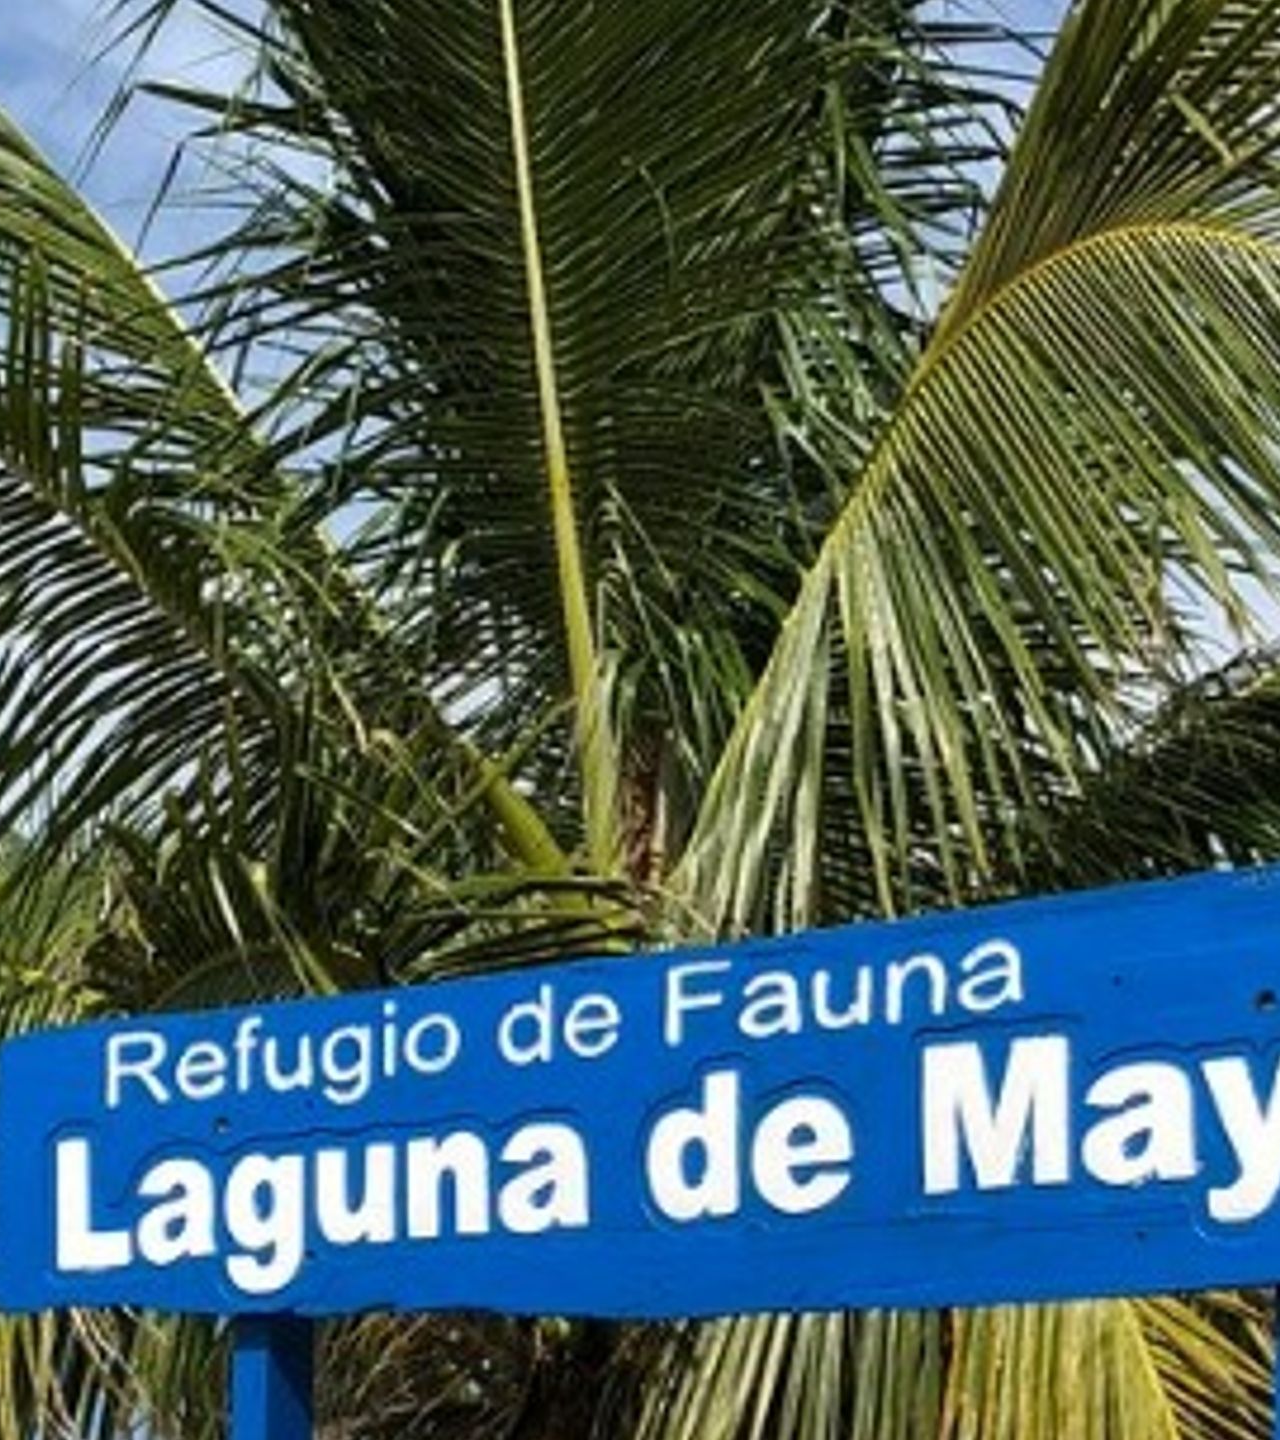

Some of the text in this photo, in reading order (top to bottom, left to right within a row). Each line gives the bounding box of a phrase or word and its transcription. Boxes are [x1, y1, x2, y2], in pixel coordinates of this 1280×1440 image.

[104, 939, 1024, 1107] Refugio de Fauna
[55, 1122, 590, 1295] Laguna
[645, 1070, 855, 1222] de
